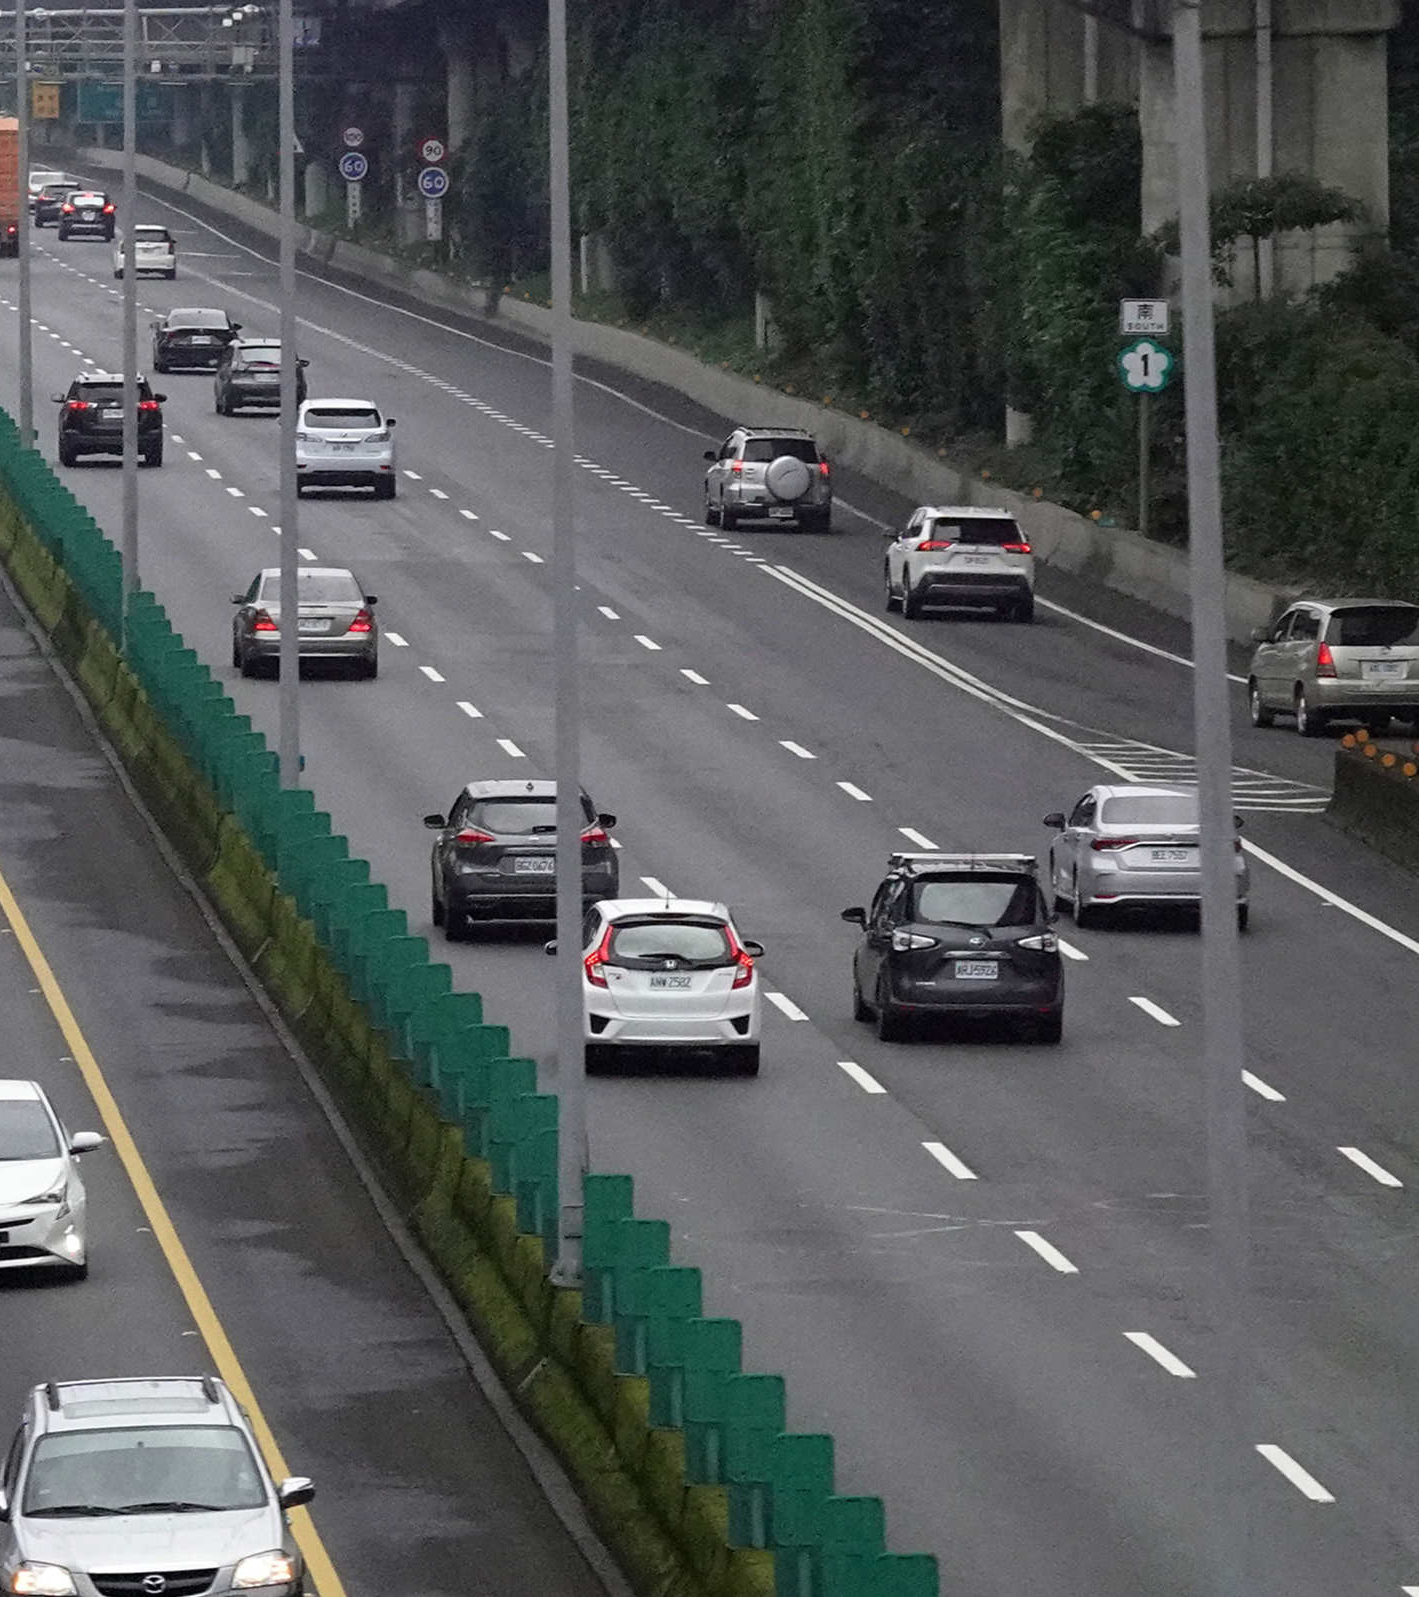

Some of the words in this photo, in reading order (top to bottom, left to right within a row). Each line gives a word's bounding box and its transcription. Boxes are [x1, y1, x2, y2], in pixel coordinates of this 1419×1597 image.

[425, 145, 441, 156] 90
[344, 160, 364, 173] 60
[423, 176, 445, 189] 60
[1137, 303, 1154, 320] 南
[1127, 322, 1164, 331] SOUTH
[1140, 353, 1149, 377] 1
